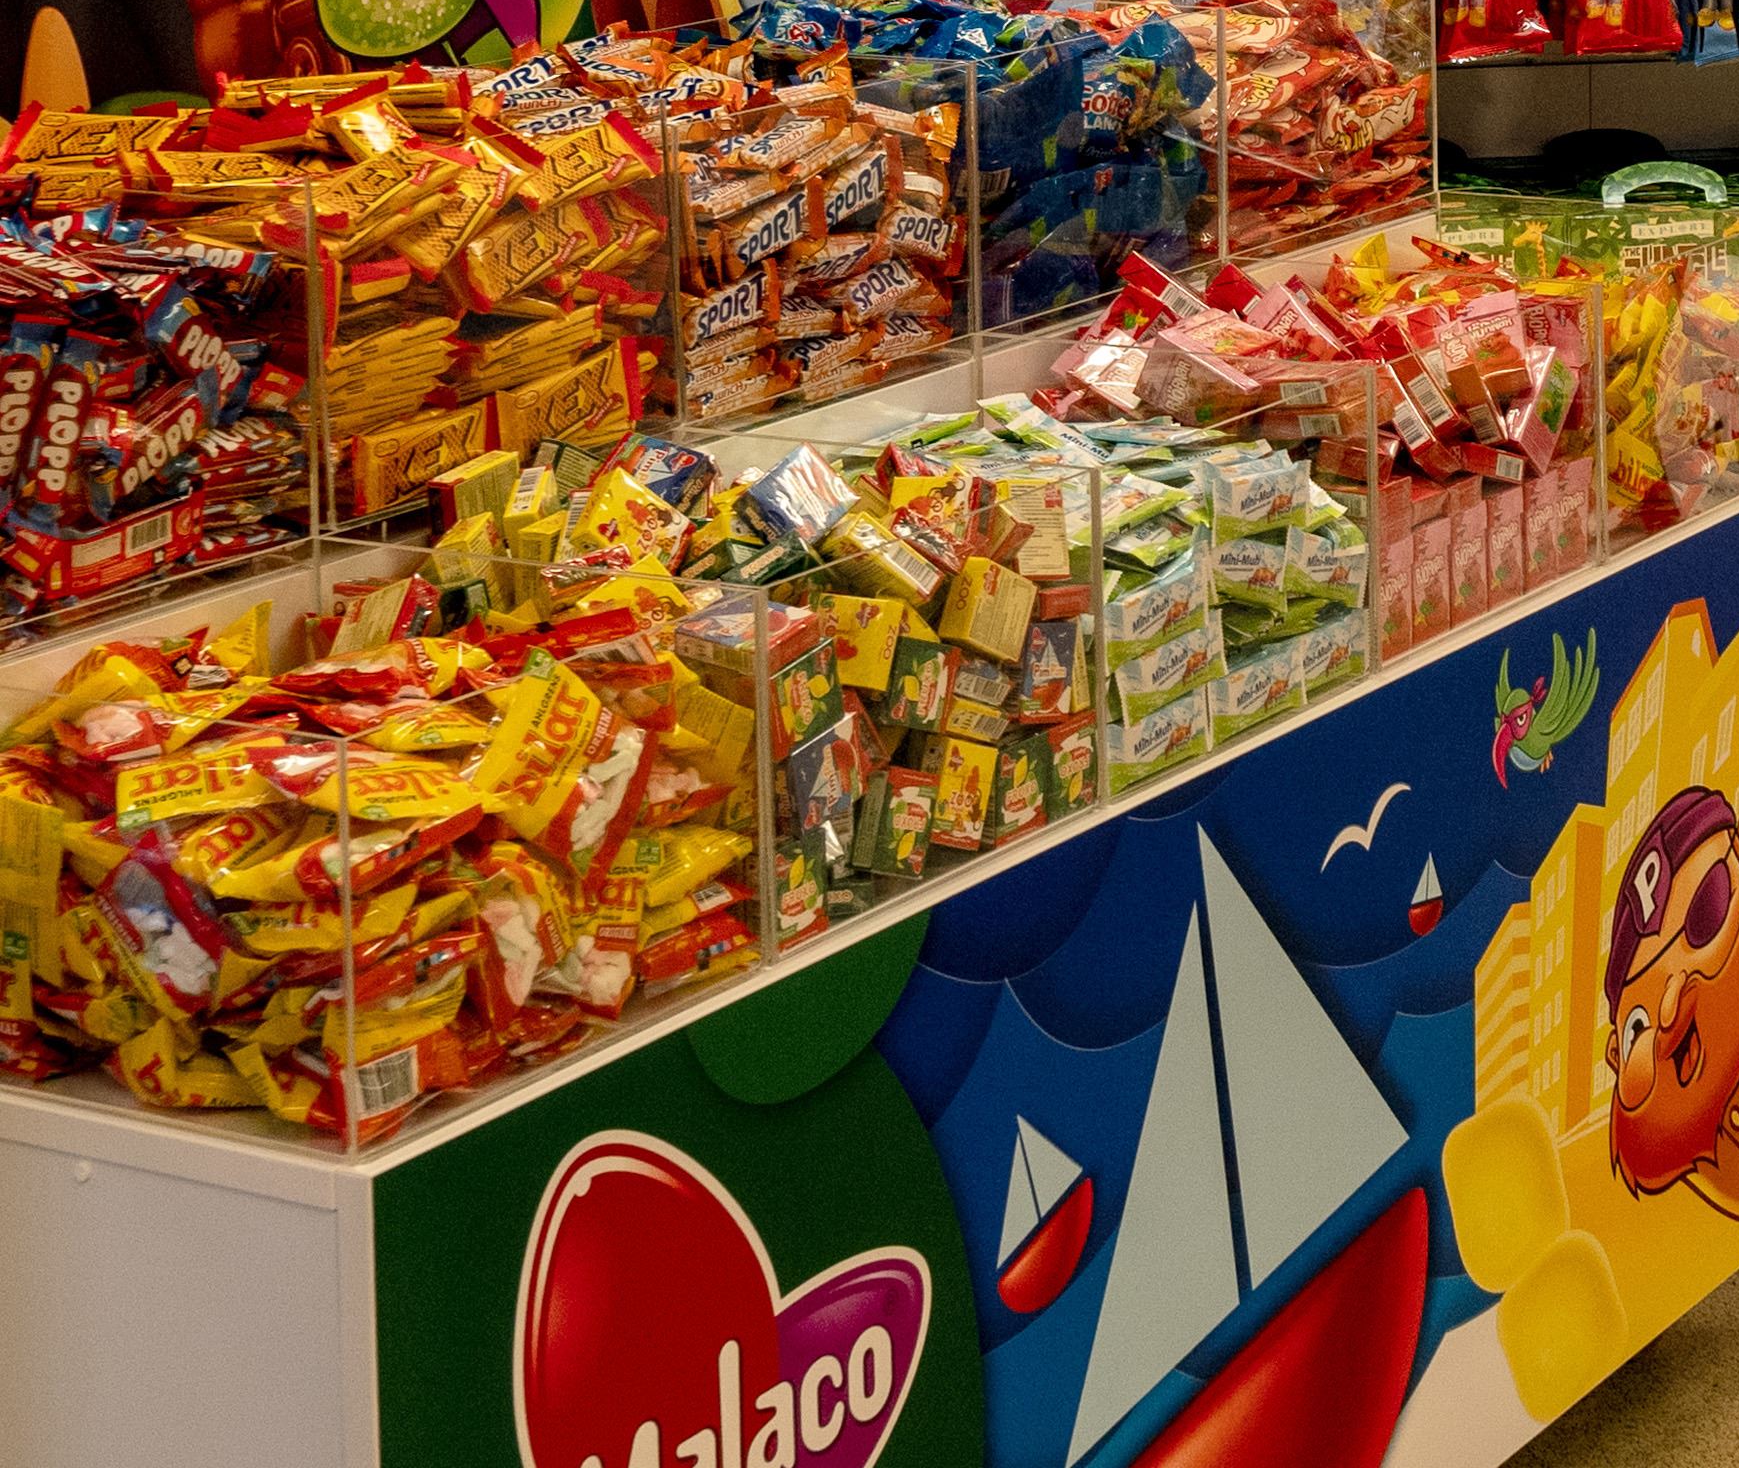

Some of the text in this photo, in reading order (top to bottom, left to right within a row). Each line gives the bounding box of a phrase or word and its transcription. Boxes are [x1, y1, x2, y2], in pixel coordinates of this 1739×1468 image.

[825, 156, 888, 227] SPORT
[739, 199, 808, 267] SPORT
[892, 216, 955, 249] SPORT
[699, 271, 769, 338] SPORT
[179, 326, 241, 391] PLOPP
[40, 380, 84, 492] PLOPP
[121, 407, 199, 494] PLOPP
[1240, 488, 1275, 512] Mini-Muh
[1220, 554, 1260, 565] Mini-Muh
[1133, 598, 1170, 632] Mini-Muh
[1237, 676, 1271, 707] Mini-Muh
[520, 684, 591, 806] bilar
[950, 791, 975, 807] ZOO
[1635, 852, 1661, 922] P
